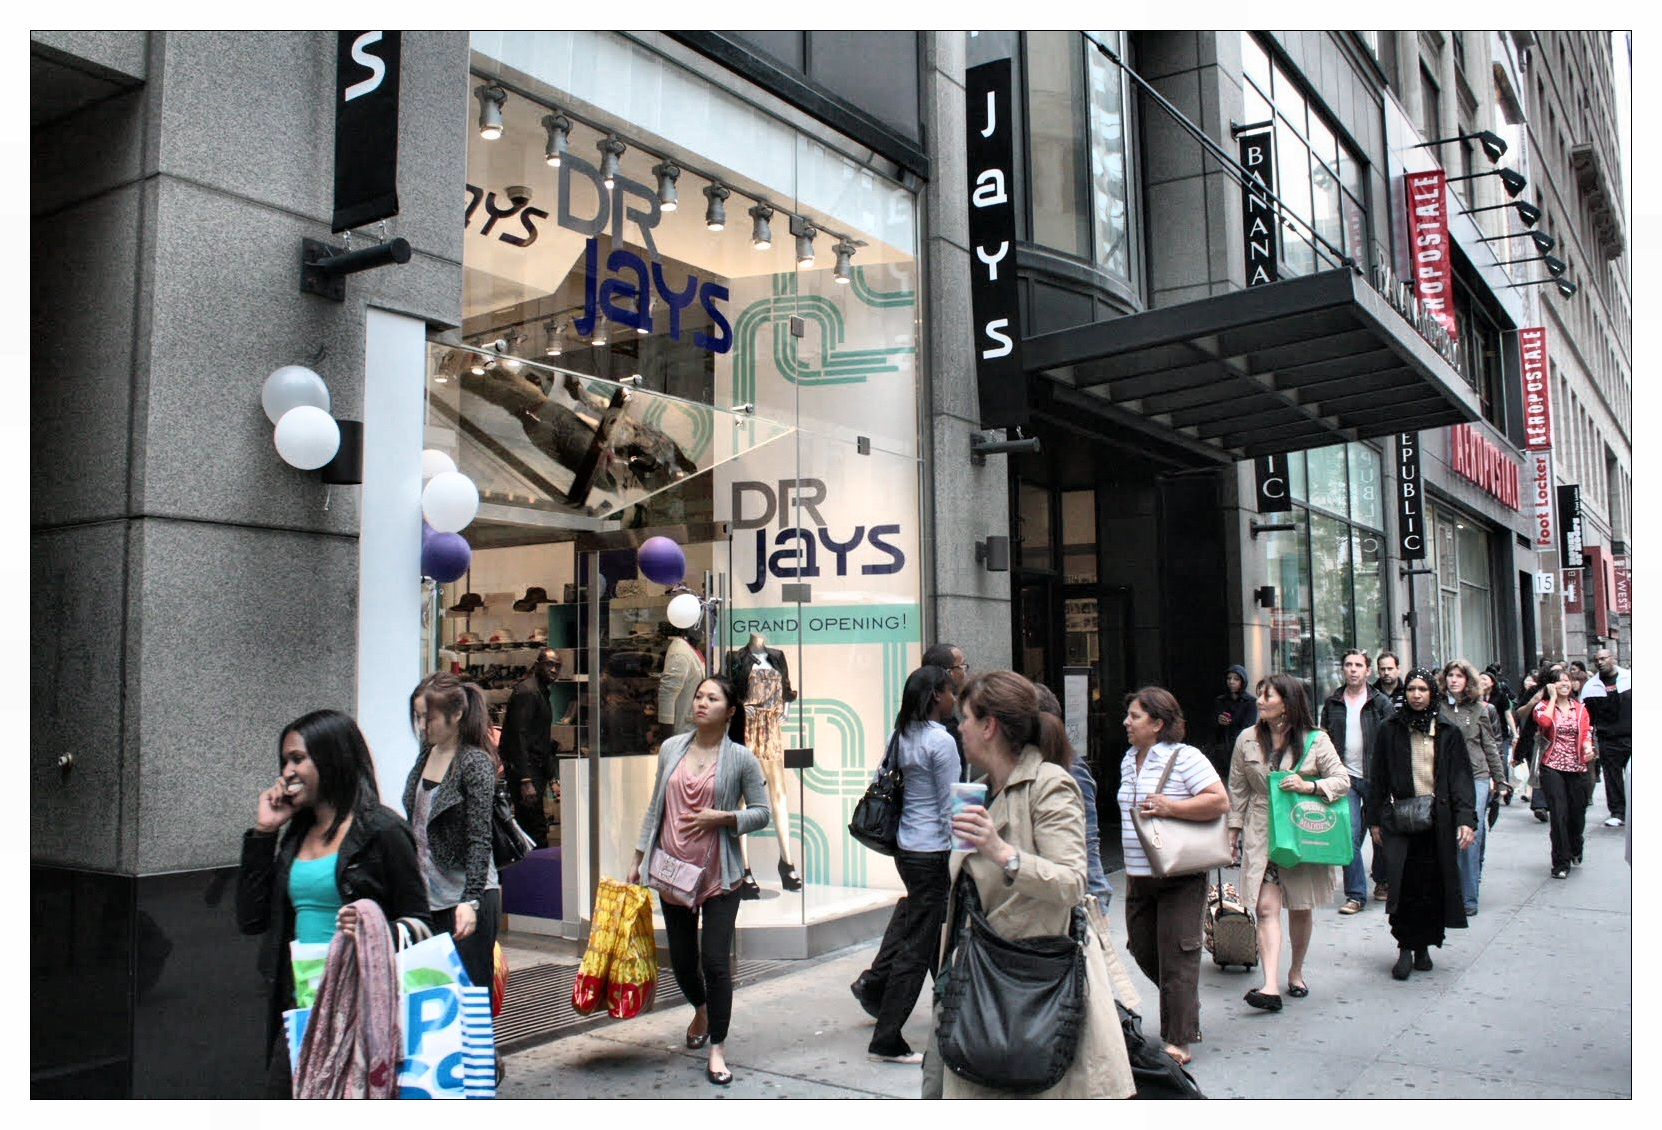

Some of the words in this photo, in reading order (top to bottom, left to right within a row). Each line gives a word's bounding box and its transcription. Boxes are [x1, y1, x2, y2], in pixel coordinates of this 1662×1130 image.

[557, 150, 662, 260] DR
[1248, 146, 1270, 285] BANANA
[1523, 331, 1546, 446] AEROPOSTALE
[731, 477, 827, 530] DR
[1534, 457, 1549, 507] Locker
[1536, 512, 1551, 546] Foot
[1537, 576, 1552, 590] 15
[733, 619, 798, 633] GRAND
[809, 613, 906, 632] OPENING!
